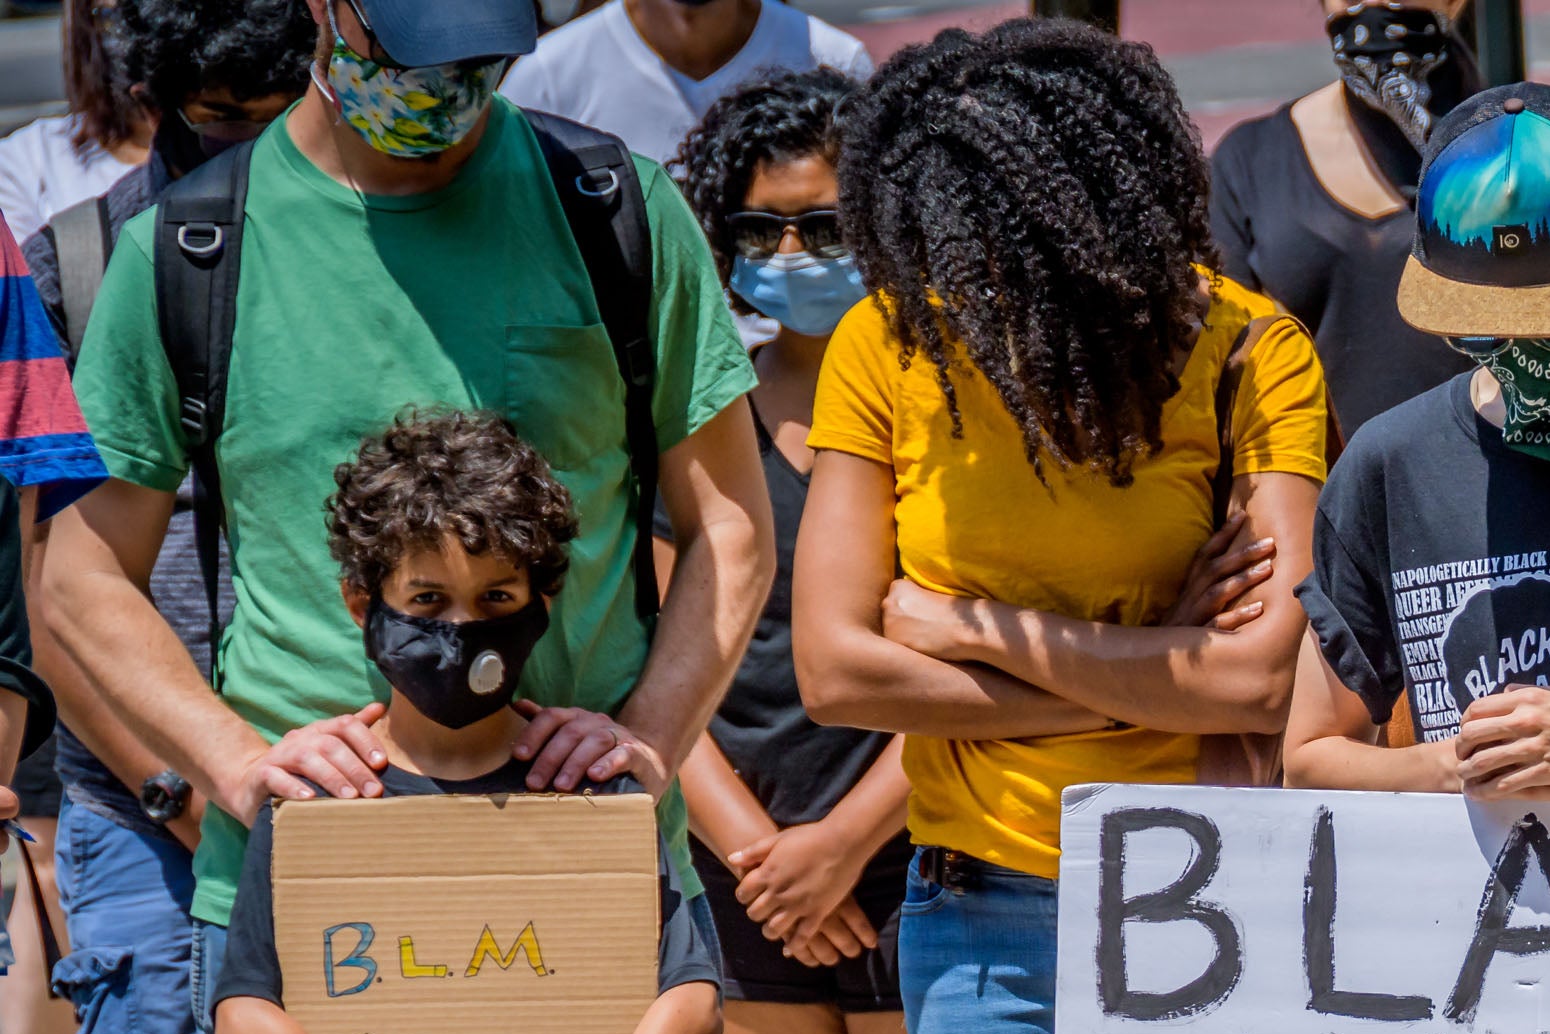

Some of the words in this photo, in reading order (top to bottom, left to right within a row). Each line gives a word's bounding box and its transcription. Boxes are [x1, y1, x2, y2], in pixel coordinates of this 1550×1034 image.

[1391, 556, 1501, 590] NAPOLOGETICALLY
[1503, 550, 1549, 572] BLACK
[1394, 586, 1443, 620] QUEER
[1408, 662, 1439, 682] BLACK
